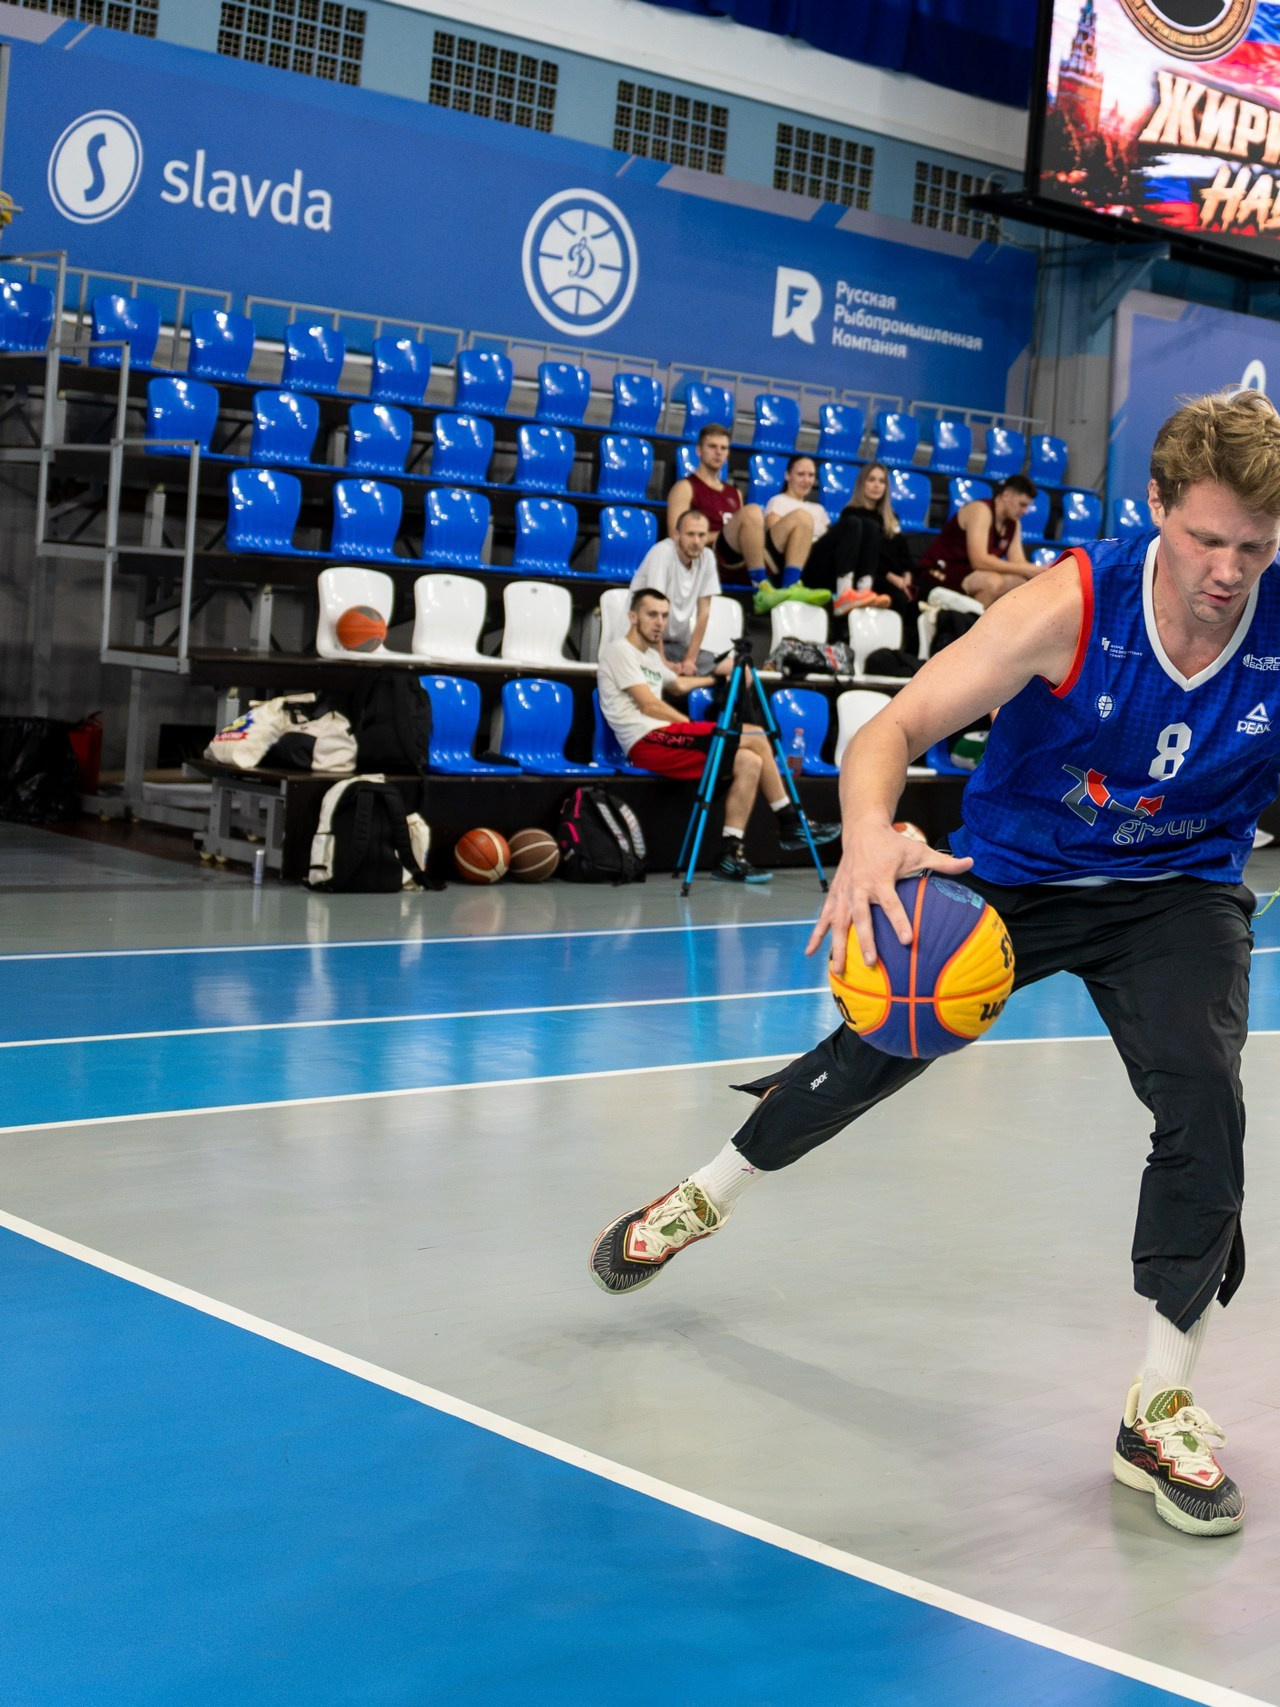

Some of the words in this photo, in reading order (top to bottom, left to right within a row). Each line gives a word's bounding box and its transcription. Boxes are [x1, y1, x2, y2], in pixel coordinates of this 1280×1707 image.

[160, 149, 333, 232] slavda
[835, 280, 897, 311] Русская
[832, 326, 907, 359] Компания
[833, 303, 983, 351] Рыбопромышленная
[1236, 720, 1273, 735] PEAK
[1148, 722, 1192, 781] 8
